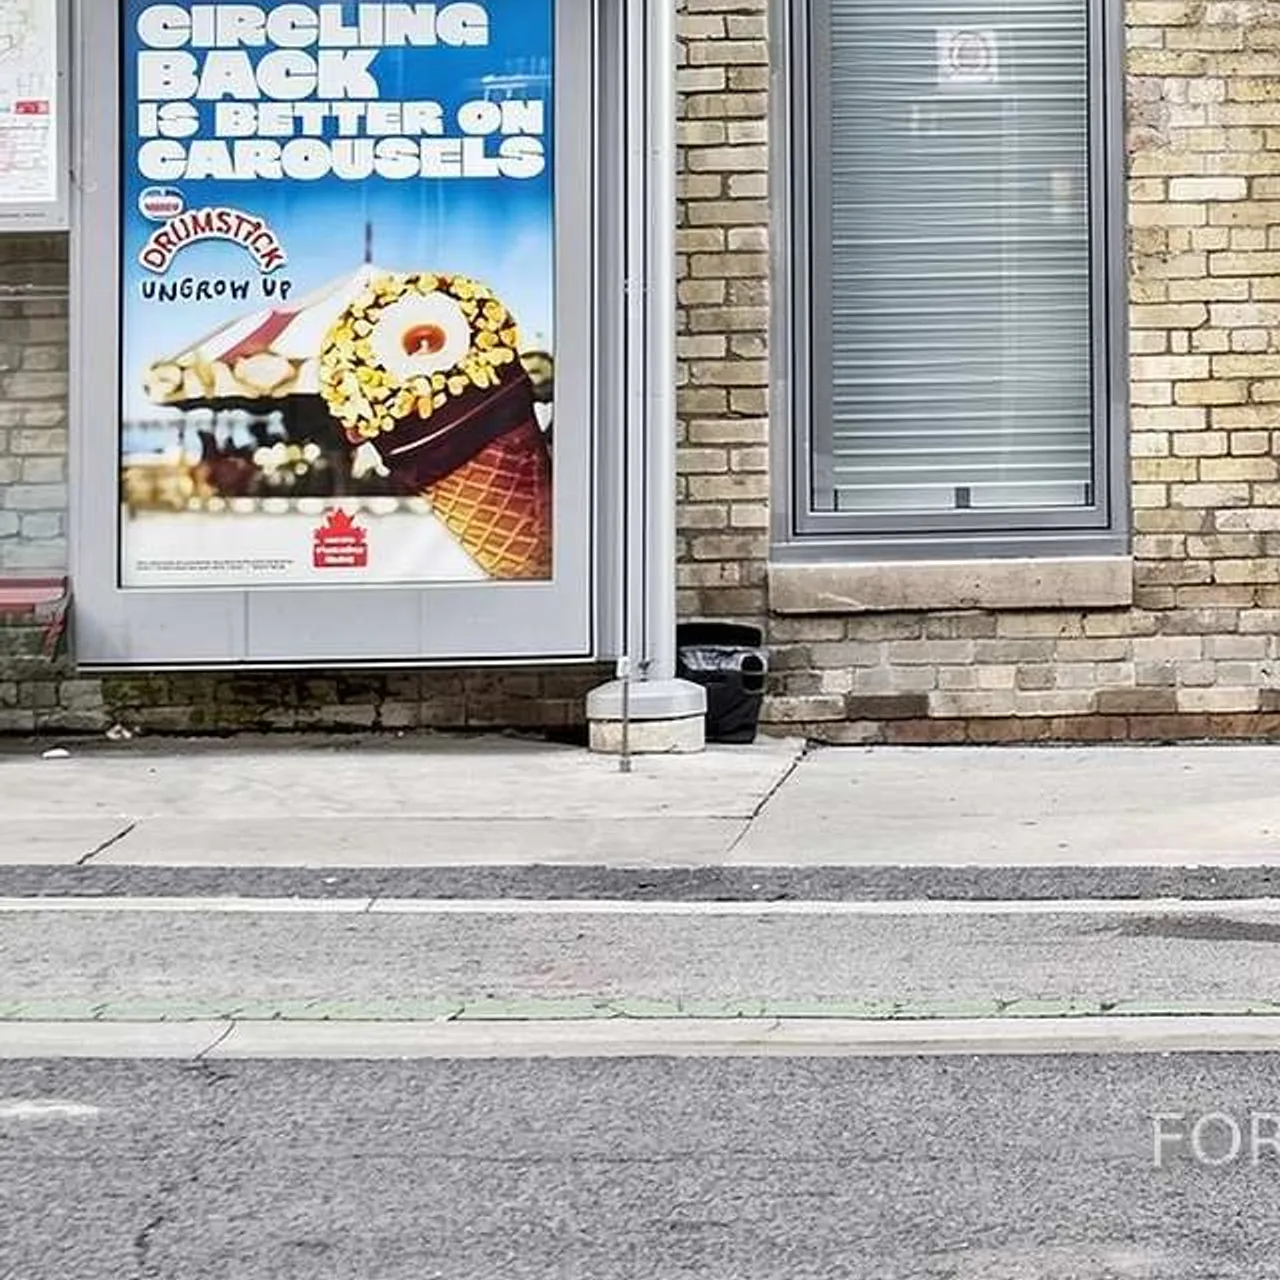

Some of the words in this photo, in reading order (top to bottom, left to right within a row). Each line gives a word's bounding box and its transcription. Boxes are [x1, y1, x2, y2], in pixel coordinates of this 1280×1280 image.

[137, 2, 488, 48] CIRCLING
[137, 51, 379, 100] BACK
[138, 101, 199, 137] IS
[215, 101, 443, 137] BETTER
[457, 100, 544, 136] ON
[138, 137, 546, 180] CAROUSELS
[142, 211, 284, 269] DRUMSTICK
[141, 278, 250, 302] UNGROW
[262, 278, 292, 301] UP
